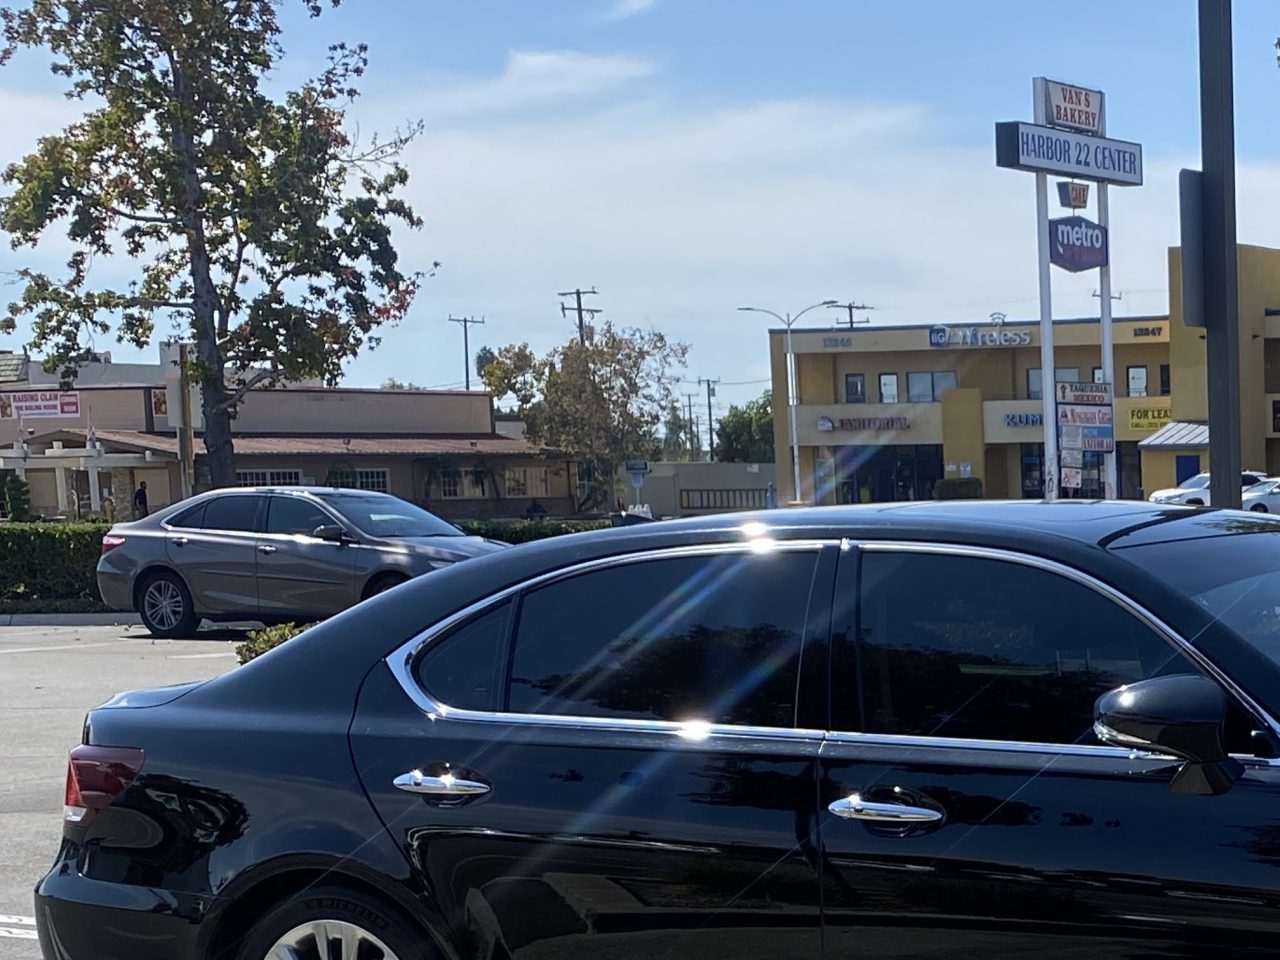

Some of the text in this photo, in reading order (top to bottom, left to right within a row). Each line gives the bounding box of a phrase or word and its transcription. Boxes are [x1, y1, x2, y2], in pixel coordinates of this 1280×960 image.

[1061, 87, 1091, 108] VAN'S
[1055, 105, 1097, 128] BAKERY
[1021, 132, 1137, 175] HARBOR 22 CENTER
[1058, 223, 1102, 249] metro
[1070, 383, 1108, 394] TAQUERIA
[40, 392, 59, 401] CLAW
[1073, 394, 1105, 403] MEXICO
[1005, 413, 1042, 427] KUM
[1131, 410, 1149, 419] FOR
